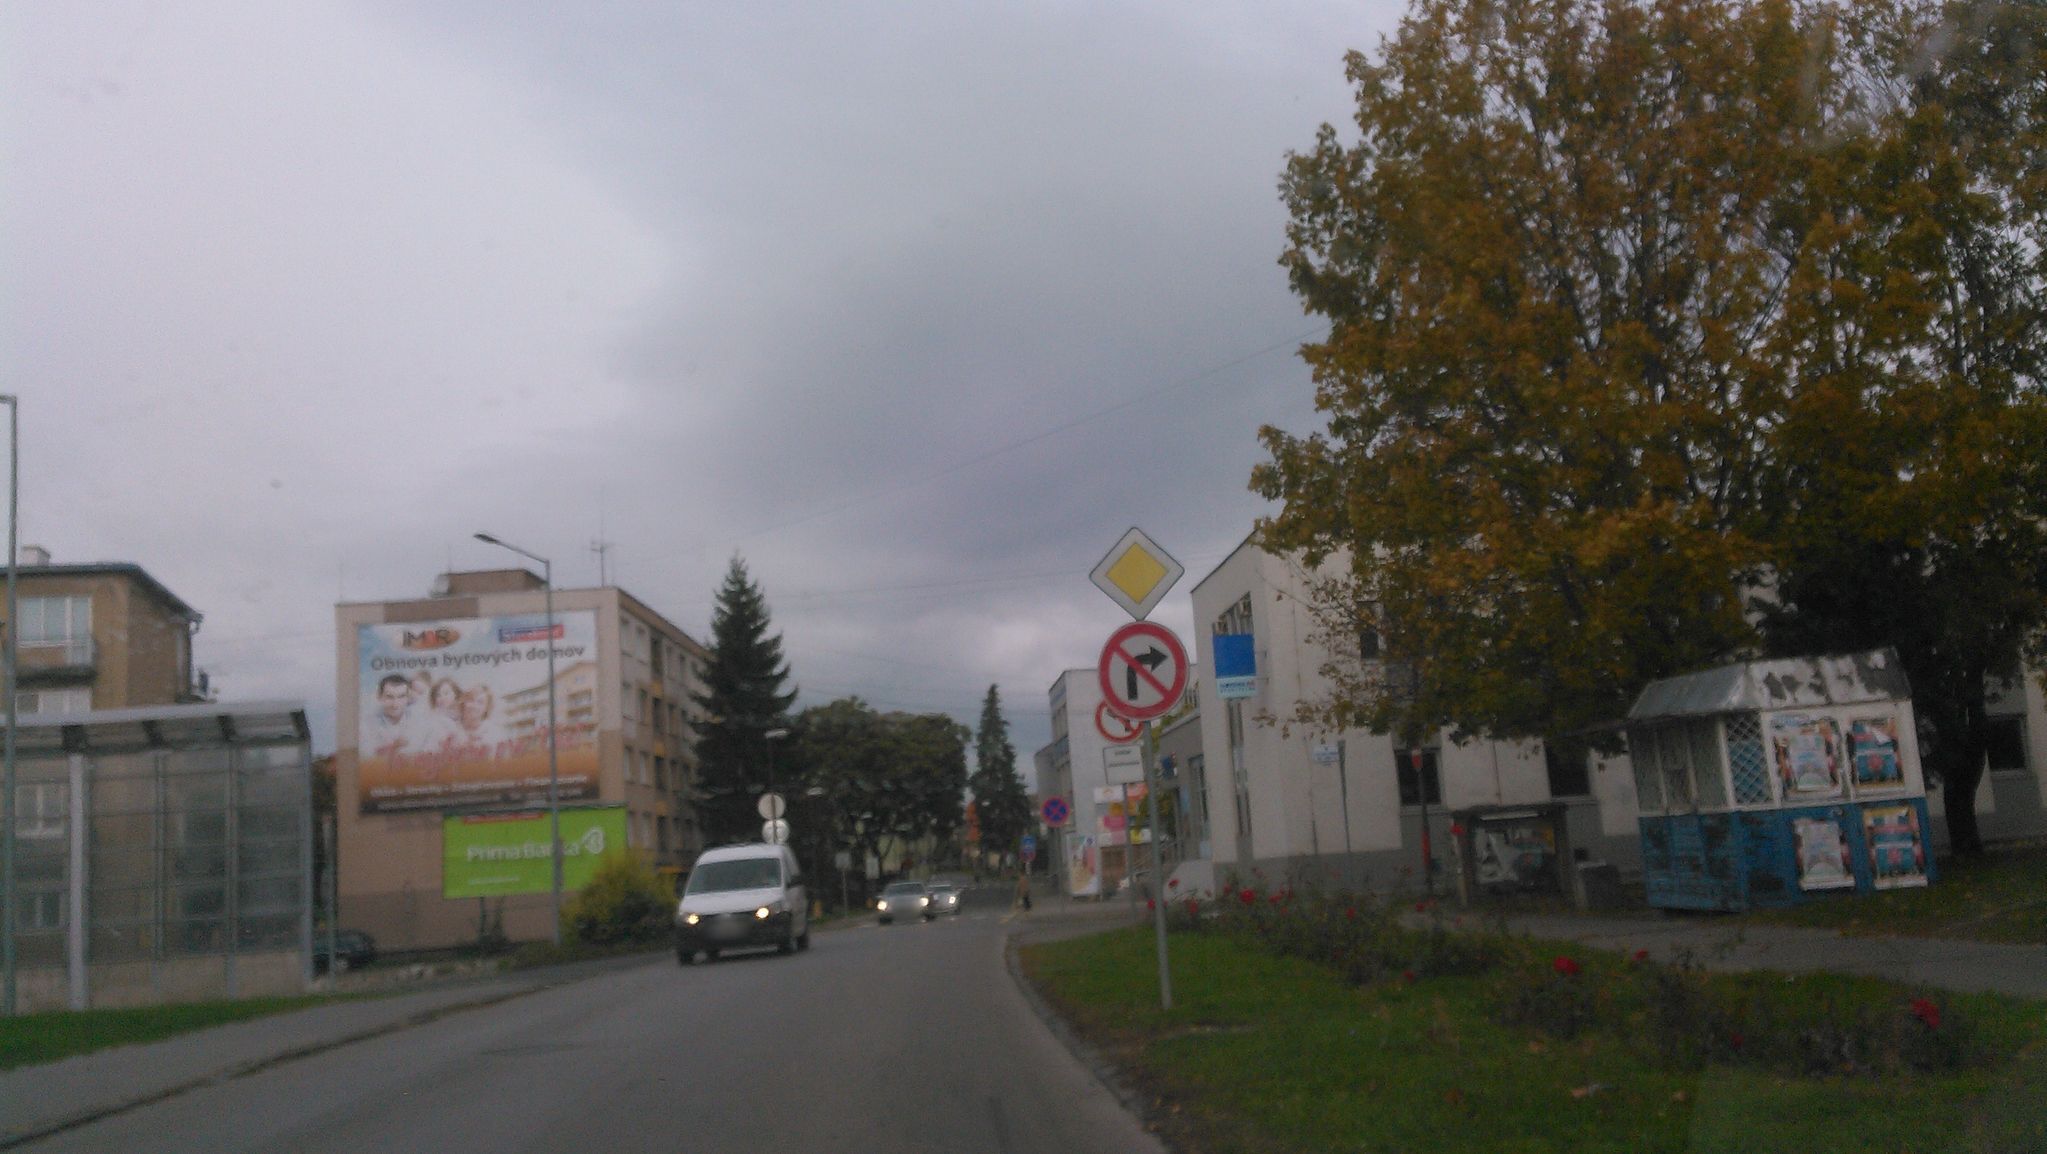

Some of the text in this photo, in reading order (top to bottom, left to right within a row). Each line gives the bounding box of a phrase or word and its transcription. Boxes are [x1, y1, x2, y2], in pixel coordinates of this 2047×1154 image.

[371, 645, 585, 671] Obnova bytových domov
